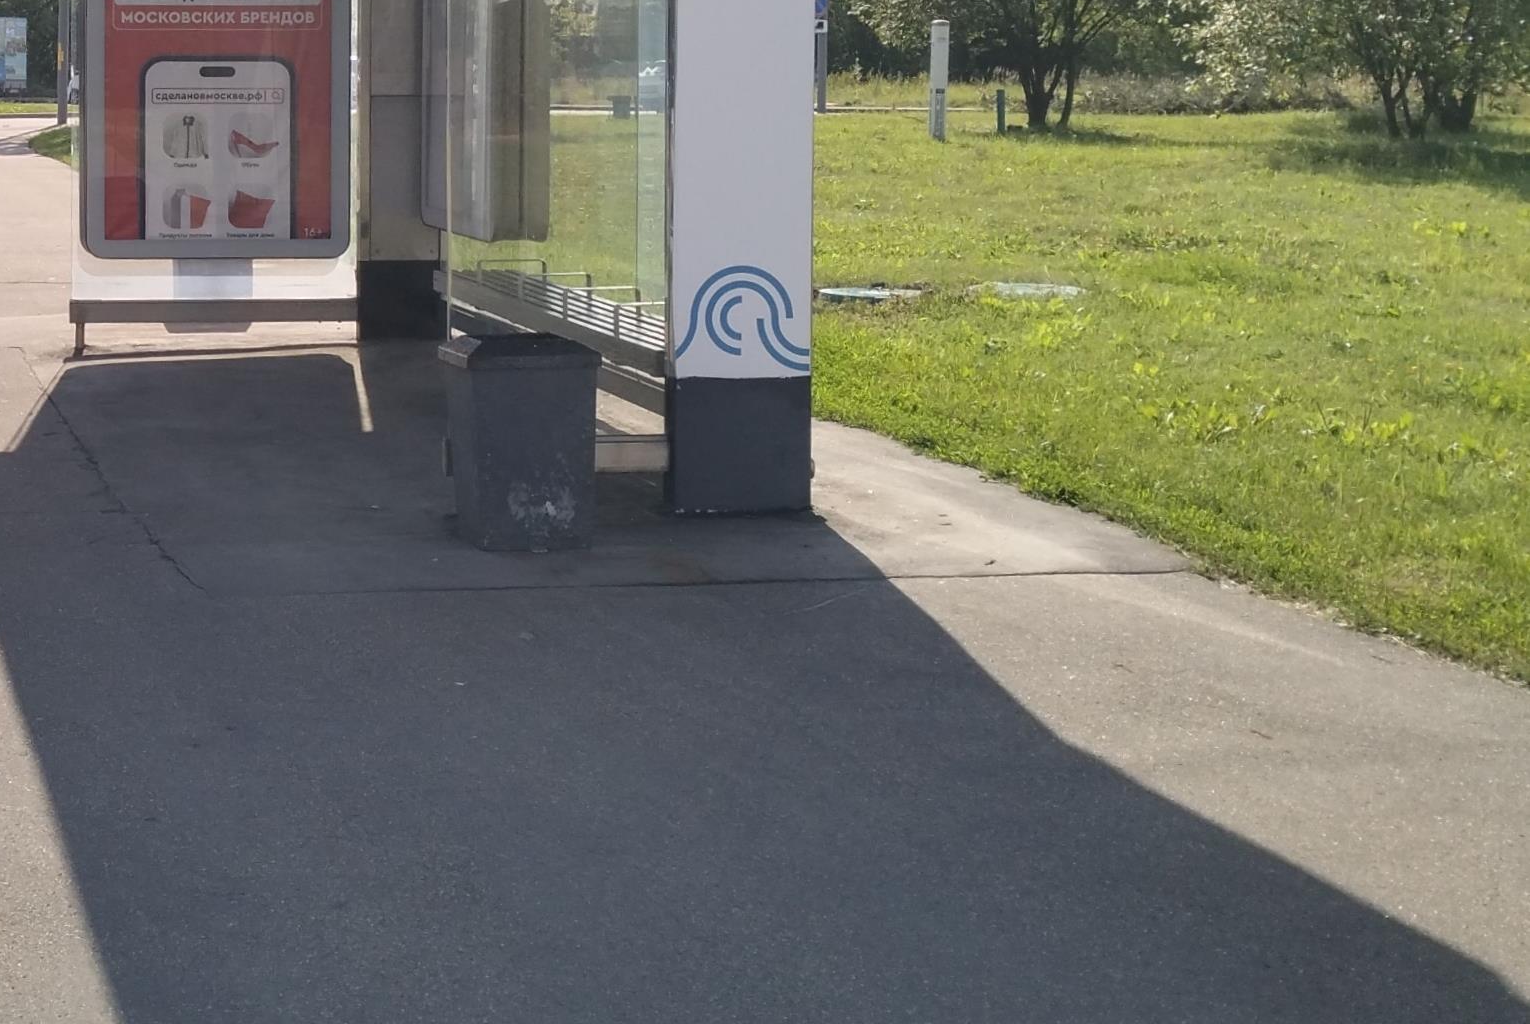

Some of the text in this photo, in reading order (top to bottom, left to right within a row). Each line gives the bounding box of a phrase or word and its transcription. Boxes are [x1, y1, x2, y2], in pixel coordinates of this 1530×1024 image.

[121, 11, 315, 26] МОСКОВСКИХ БРЕНДОВ
[155, 91, 263, 103] сделановмоскве.рф
